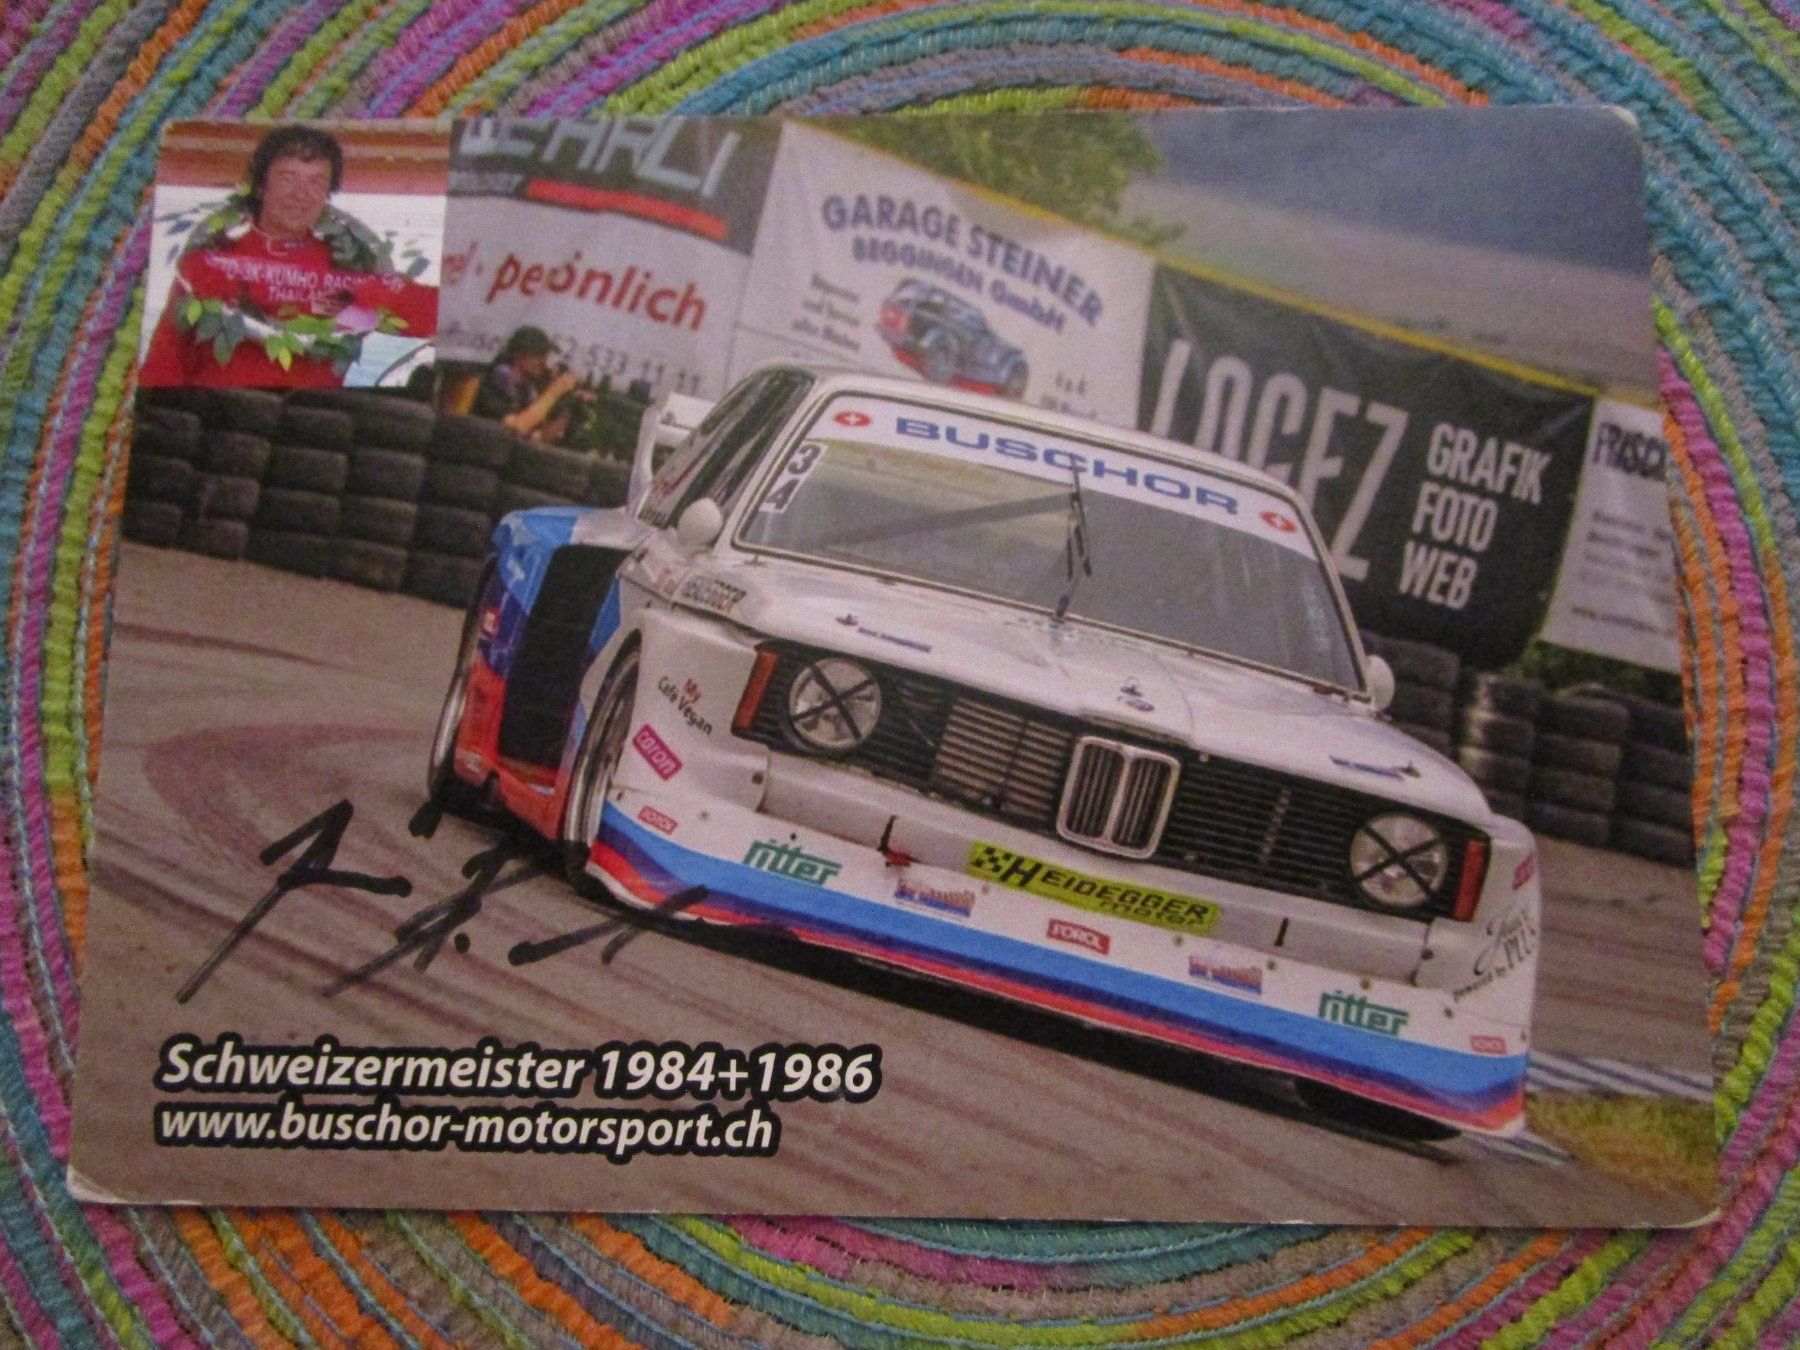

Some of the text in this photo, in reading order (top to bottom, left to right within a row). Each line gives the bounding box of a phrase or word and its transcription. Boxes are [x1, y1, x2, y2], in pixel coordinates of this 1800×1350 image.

[822, 194, 1103, 327] GARAGE STEINER
[894, 415, 1239, 517] BUSCHOR
[1427, 422, 1552, 506] GRAFIK
[1412, 481, 1499, 553] FOTO
[1398, 540, 1479, 611] WEB
[678, 695, 713, 737] Vegan
[1000, 855, 1209, 921] HEIDEGGER
[161, 1041, 874, 1094] Schweizermeister 1984+1986
[161, 1101, 773, 1156] www.buschor-motorsport.ch
